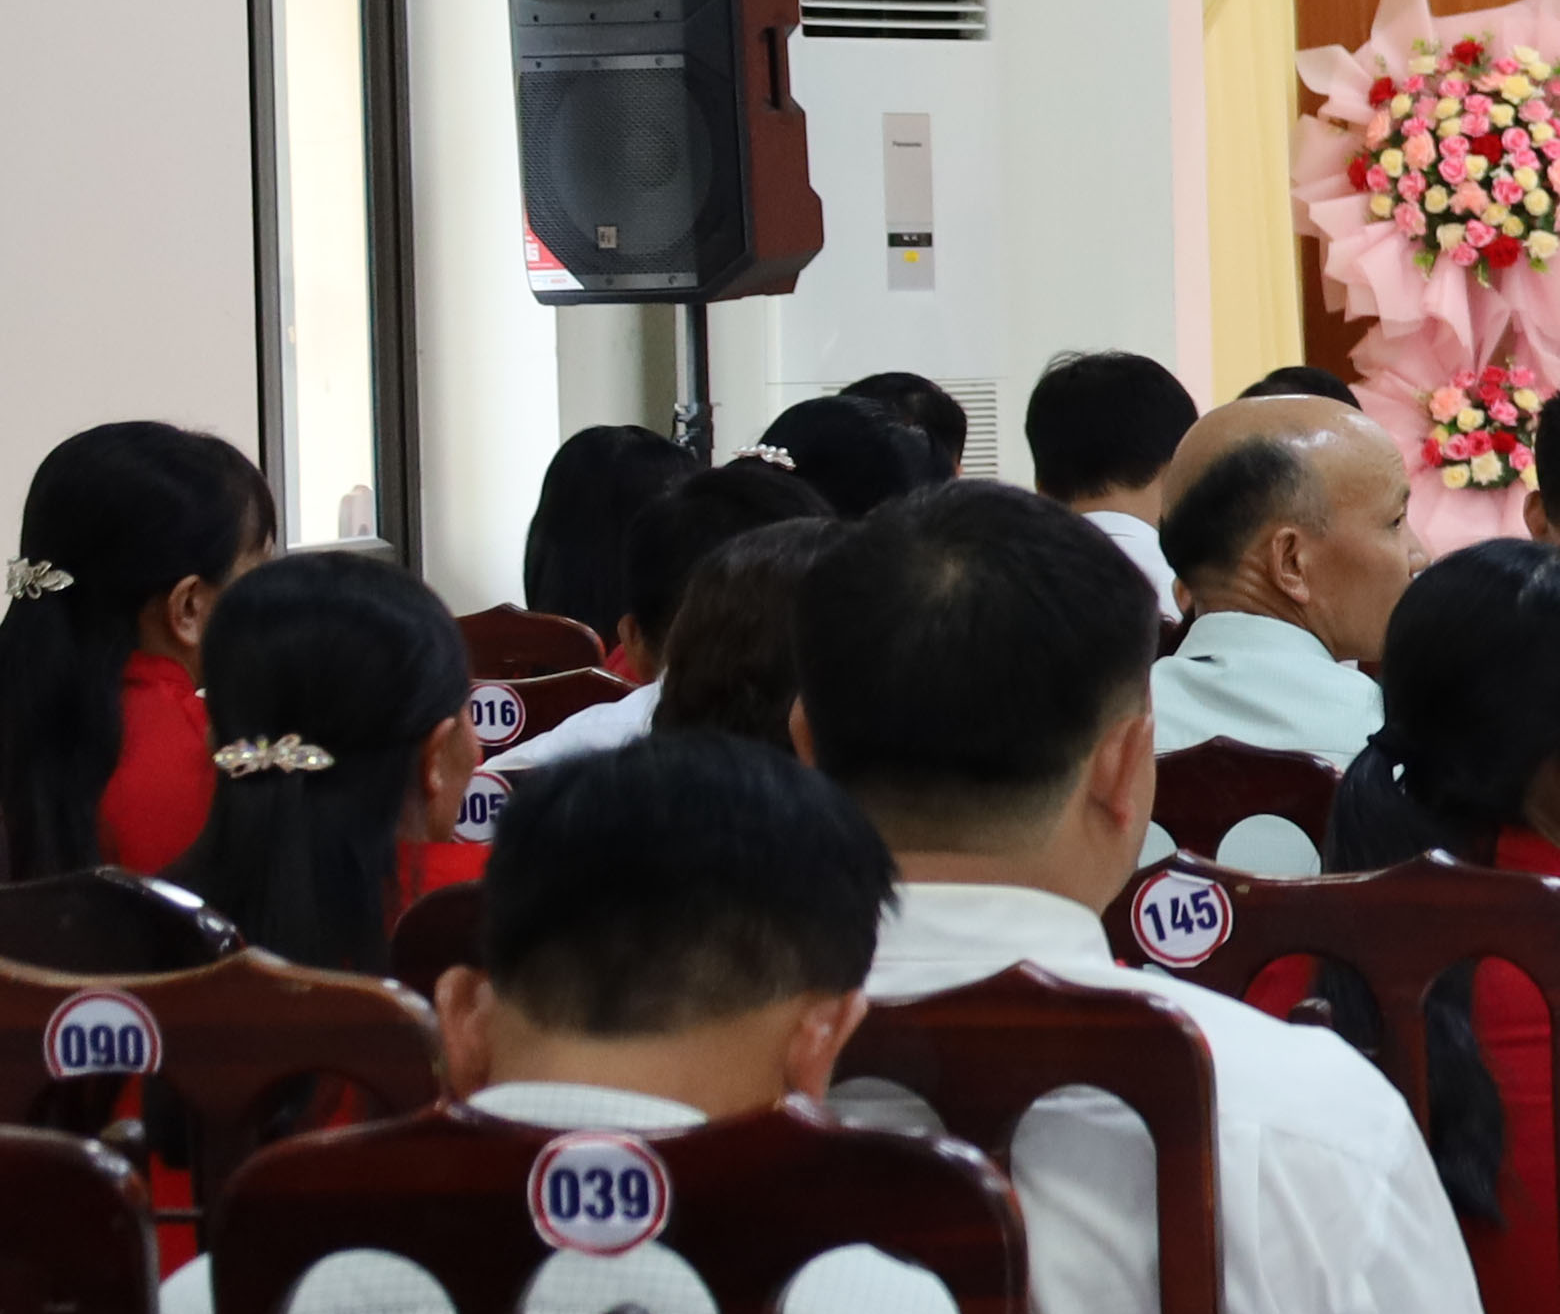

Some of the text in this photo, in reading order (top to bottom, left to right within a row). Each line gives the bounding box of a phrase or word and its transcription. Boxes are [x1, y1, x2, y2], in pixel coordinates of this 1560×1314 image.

[471, 699, 516, 727] 016
[1143, 888, 1218, 942] 145
[61, 1023, 144, 1068] 090
[548, 1167, 651, 1221] 039
